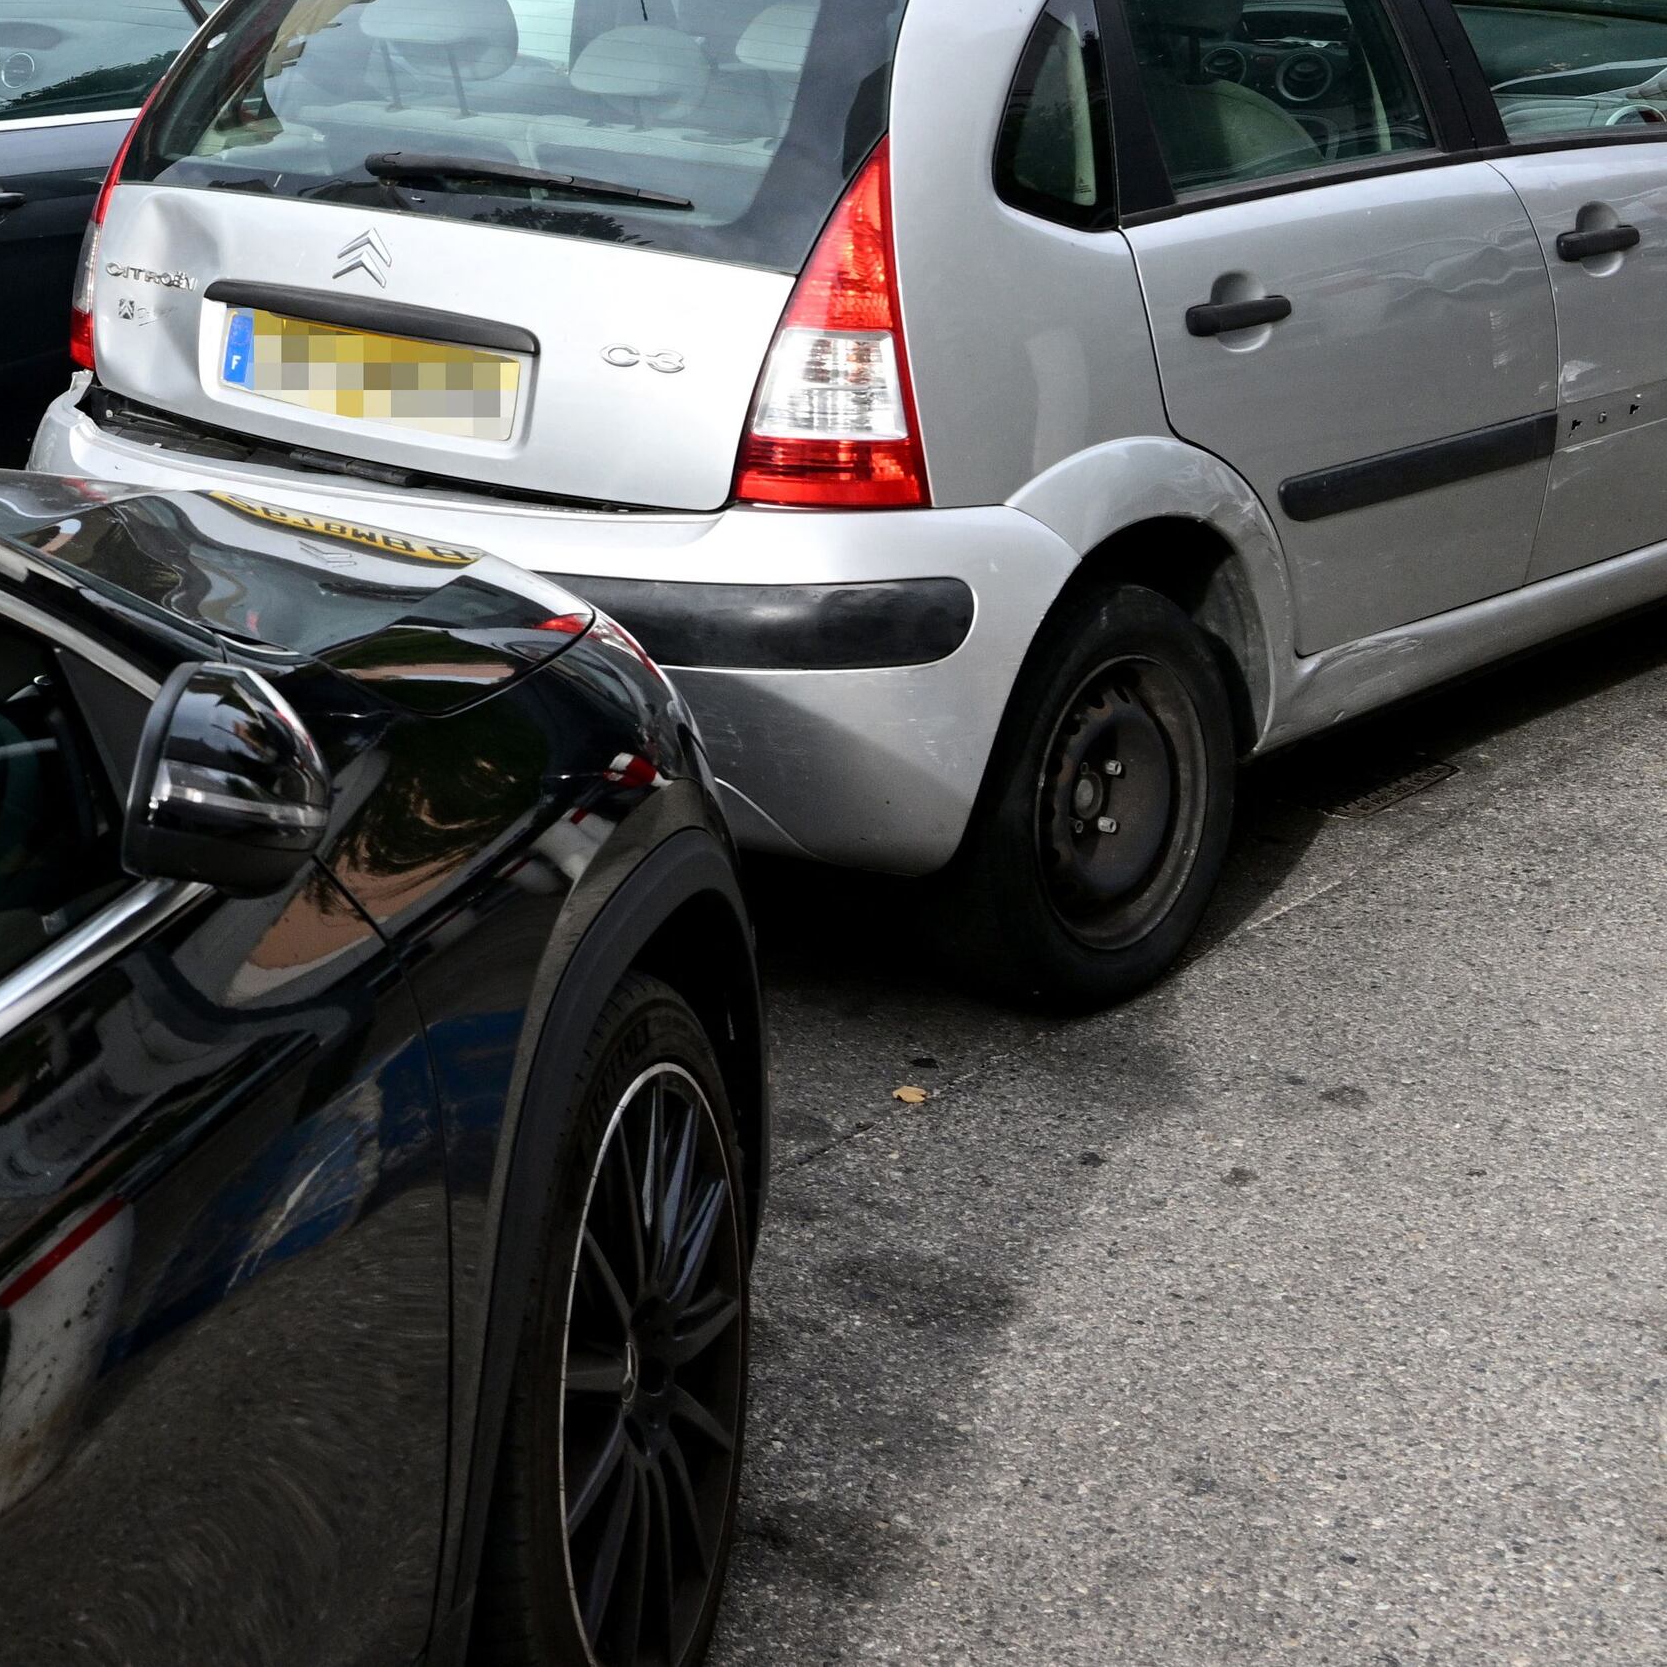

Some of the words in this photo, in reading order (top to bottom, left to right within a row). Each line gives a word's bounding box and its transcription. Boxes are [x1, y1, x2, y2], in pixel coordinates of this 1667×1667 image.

[104, 261, 199, 292] CITROËN
[230, 355, 241, 371] F
[600, 342, 687, 374] C3
